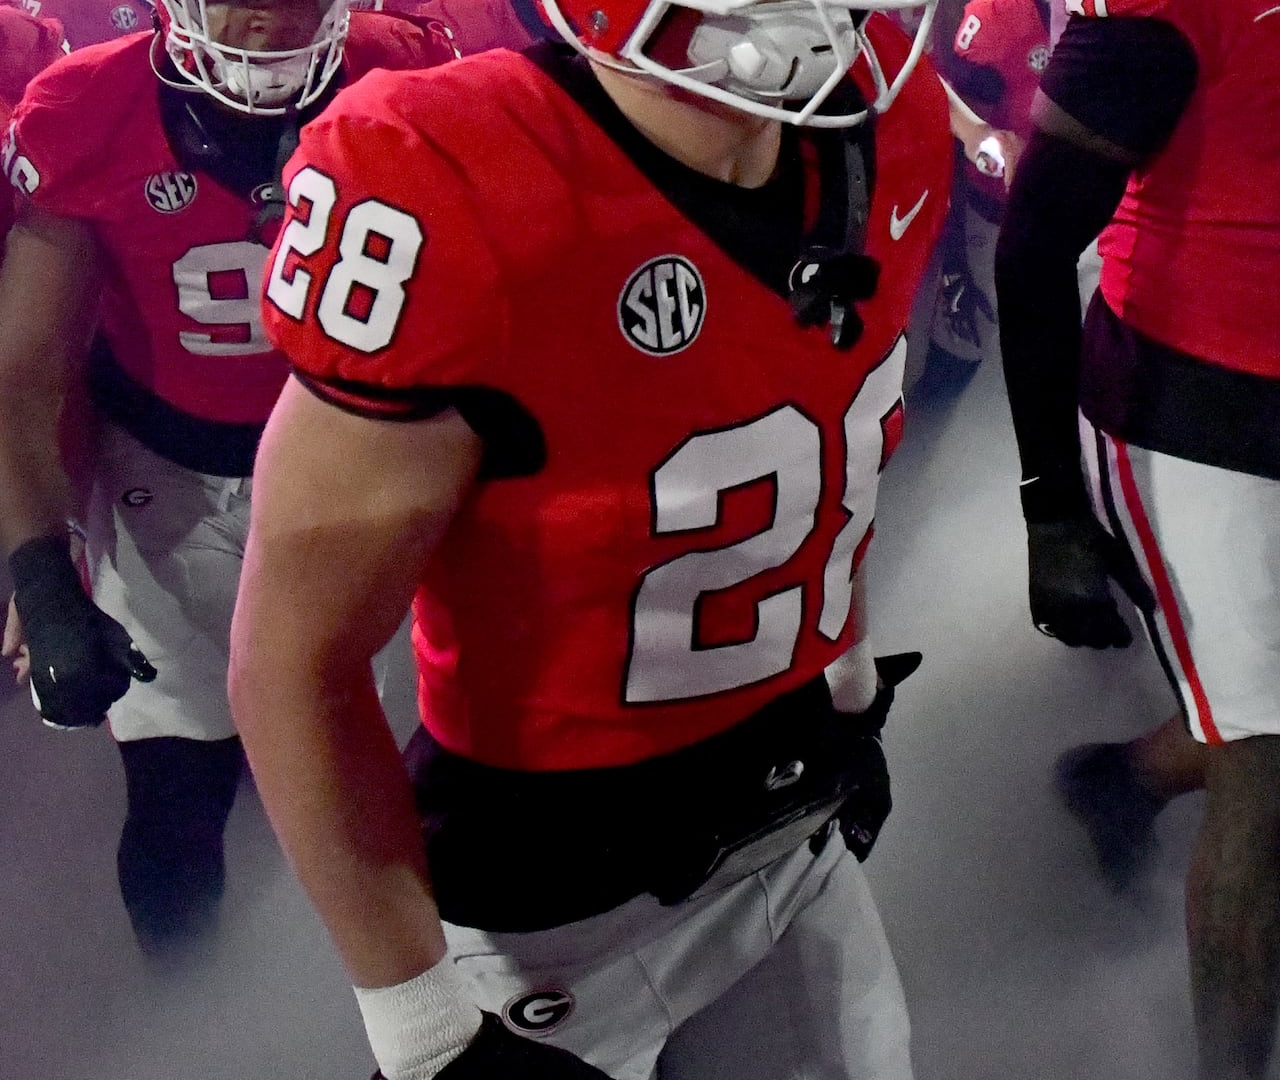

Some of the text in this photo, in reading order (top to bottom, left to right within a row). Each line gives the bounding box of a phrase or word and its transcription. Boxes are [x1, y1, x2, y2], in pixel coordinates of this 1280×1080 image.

[957, 15, 982, 51] 8
[149, 170, 196, 213] SEC
[267, 167, 424, 353] 28
[623, 260, 702, 350] SEC
